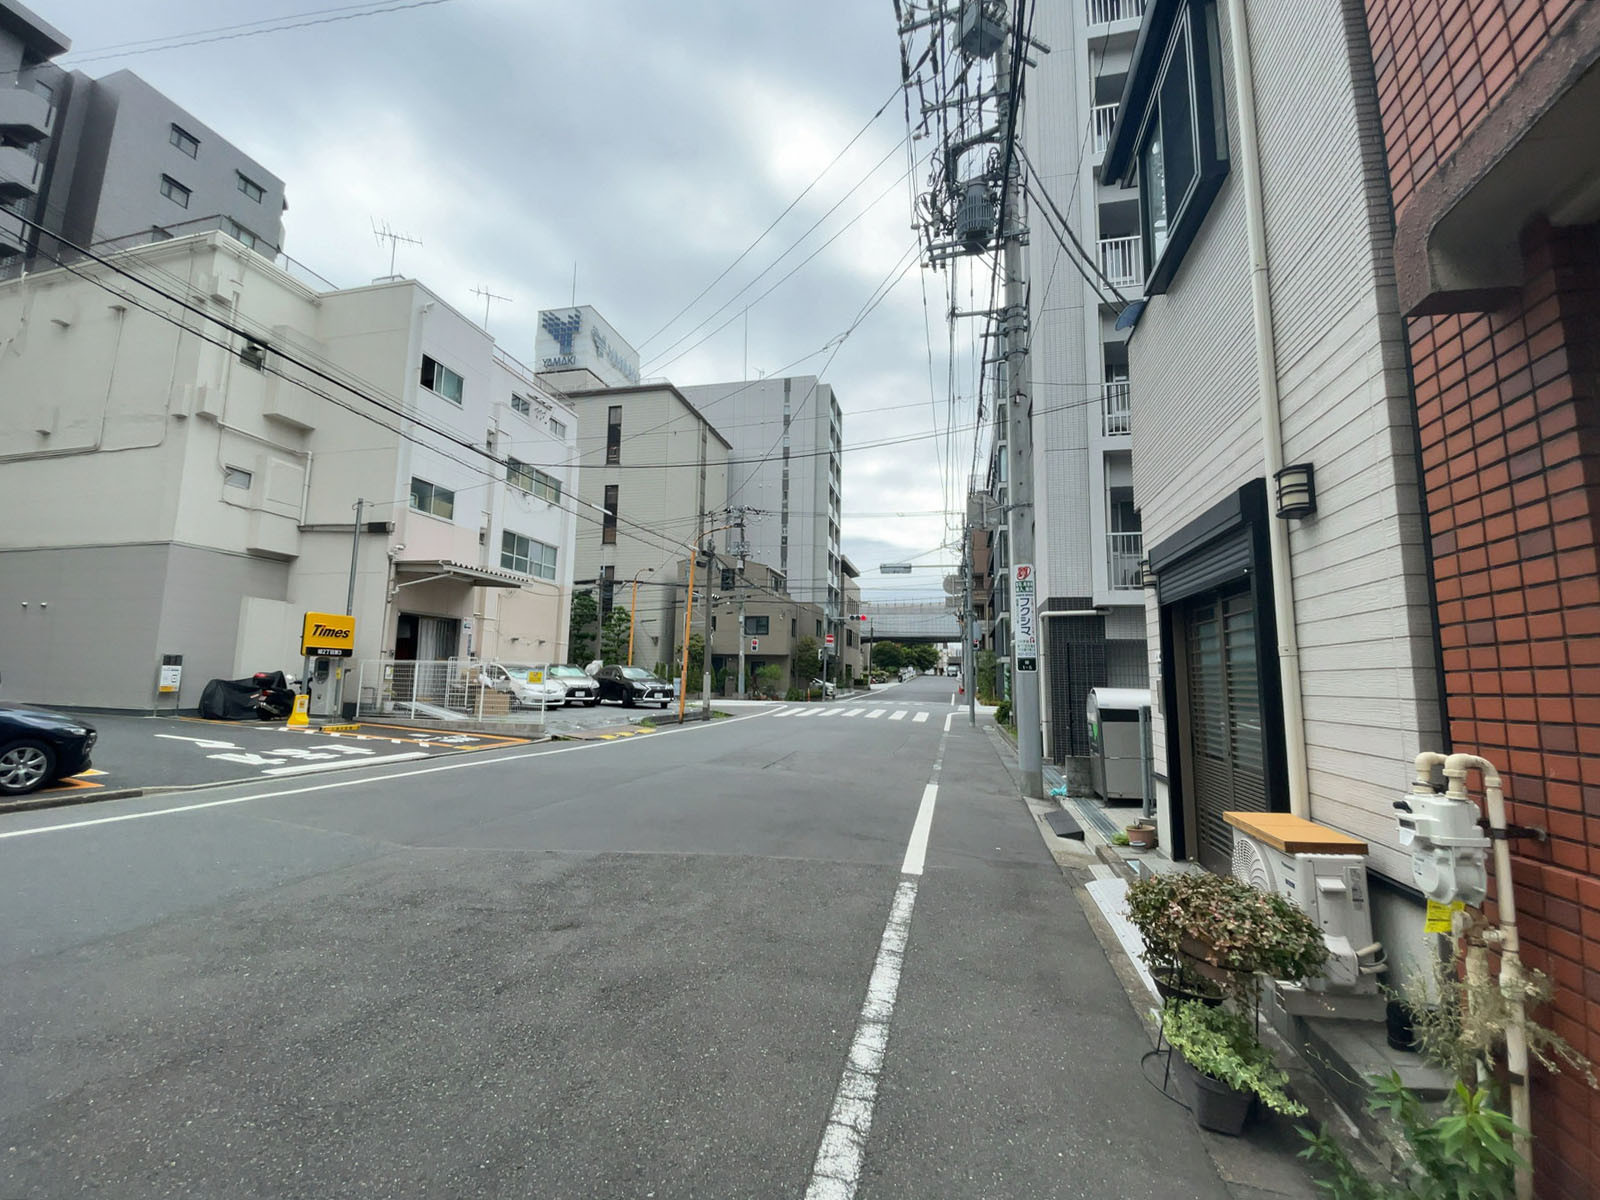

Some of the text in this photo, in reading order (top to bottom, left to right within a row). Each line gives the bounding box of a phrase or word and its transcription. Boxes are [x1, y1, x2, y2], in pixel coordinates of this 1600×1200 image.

[542, 355, 576, 368] YAMAKI
[1020, 598, 1031, 636] フクシマ
[312, 623, 351, 638] Times
